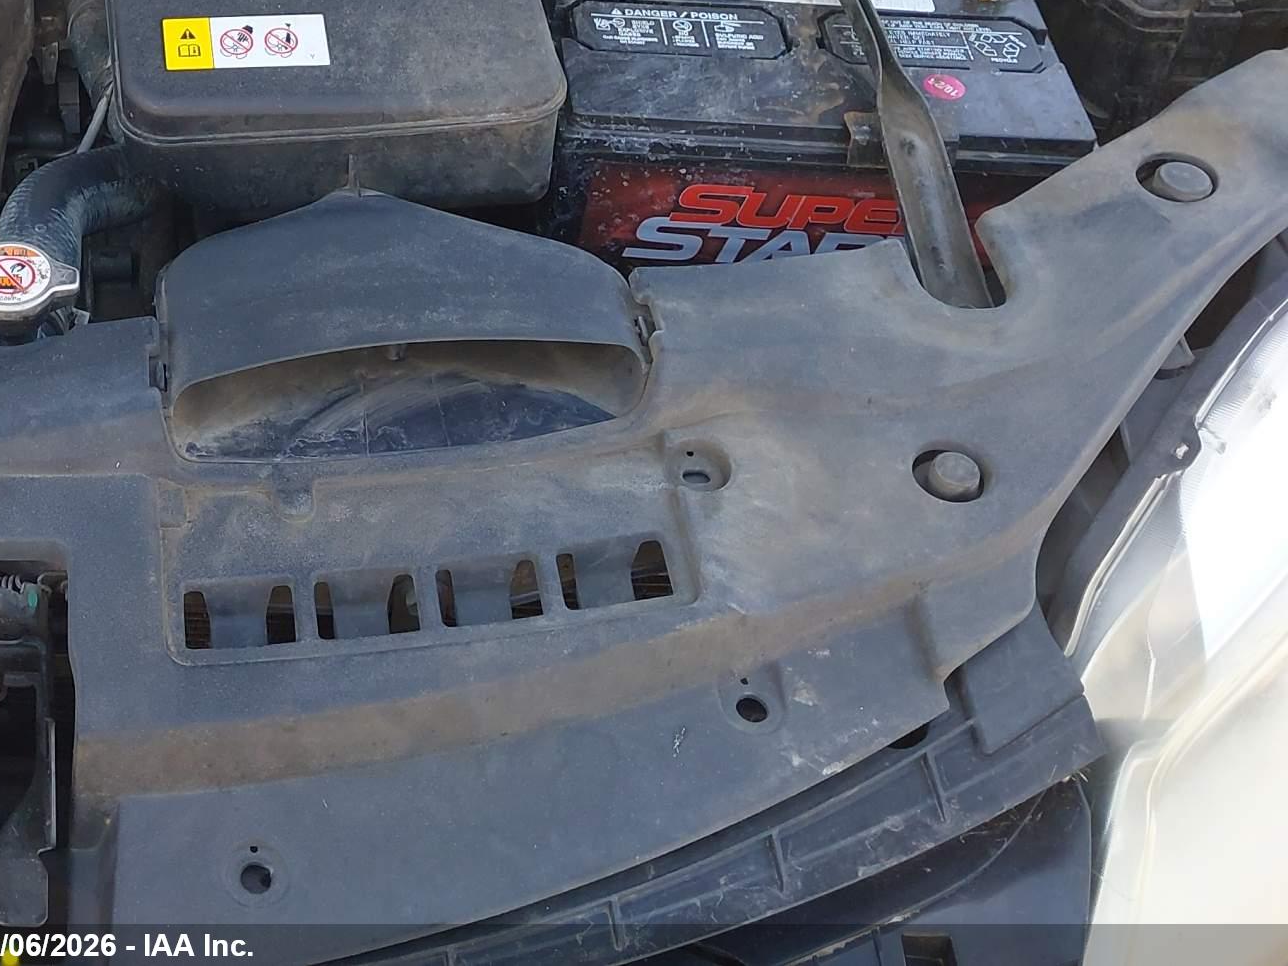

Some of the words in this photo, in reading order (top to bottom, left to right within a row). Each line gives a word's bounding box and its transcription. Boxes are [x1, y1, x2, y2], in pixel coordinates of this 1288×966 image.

[624, 8, 677, 18] DANGER
[691, 12, 738, 21] POISON
[669, 184, 906, 235] SUPE
[622, 217, 906, 264] STAR
